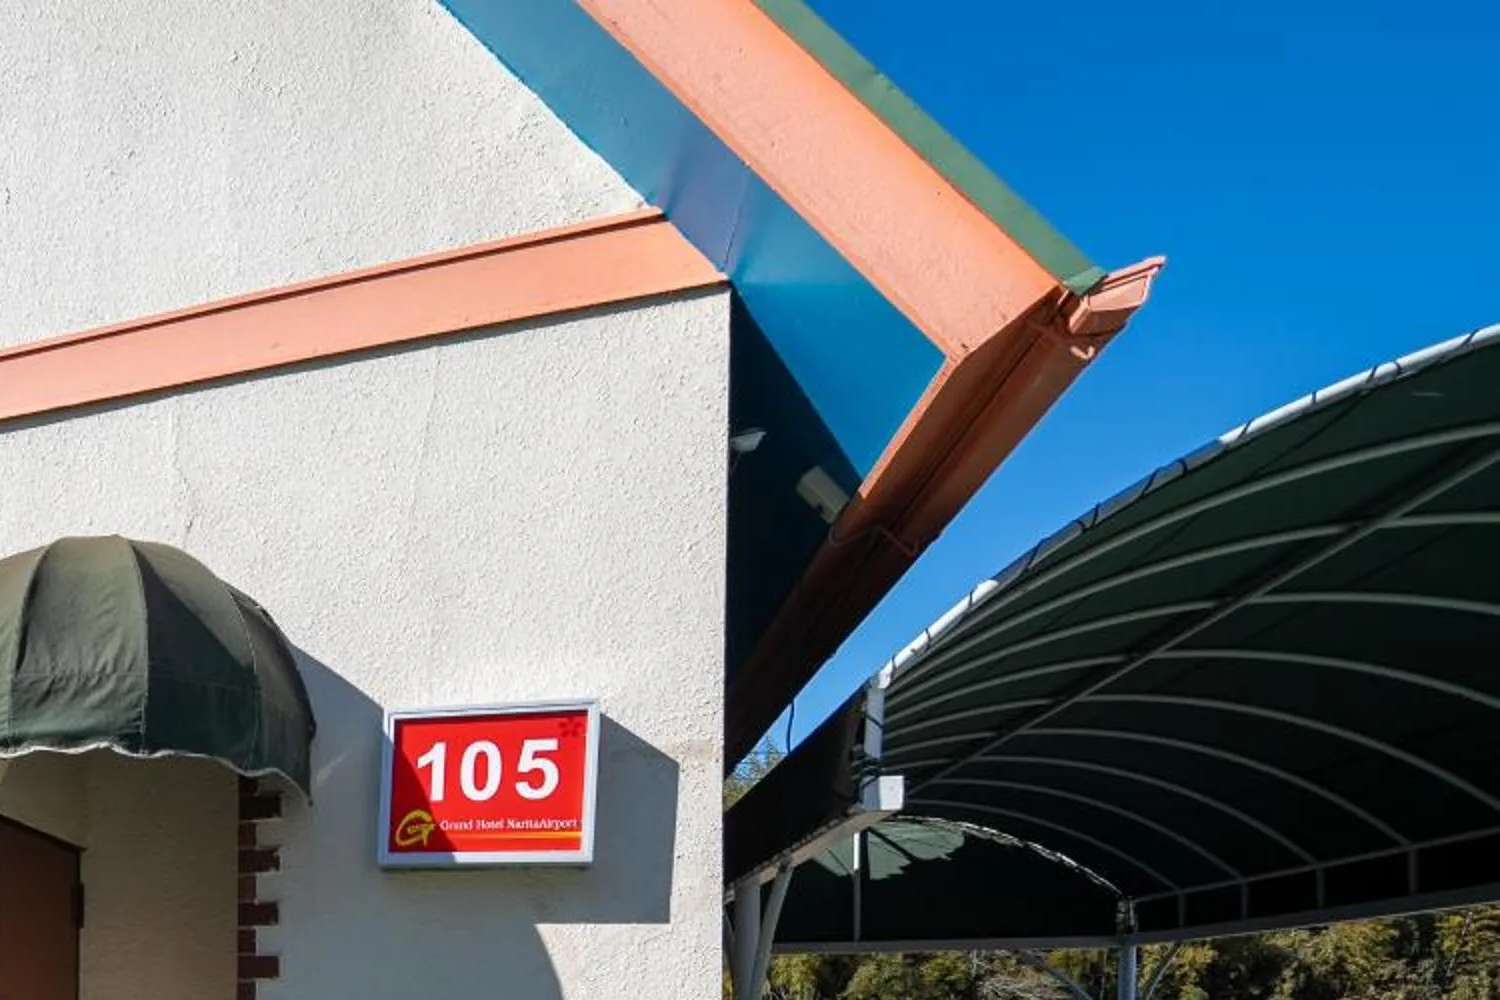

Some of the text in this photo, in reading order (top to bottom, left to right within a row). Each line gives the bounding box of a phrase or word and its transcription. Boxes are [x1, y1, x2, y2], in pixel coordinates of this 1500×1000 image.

[417, 738, 560, 802] 105
[439, 818, 473, 831] Grand
[475, 817, 505, 830] Hotel
